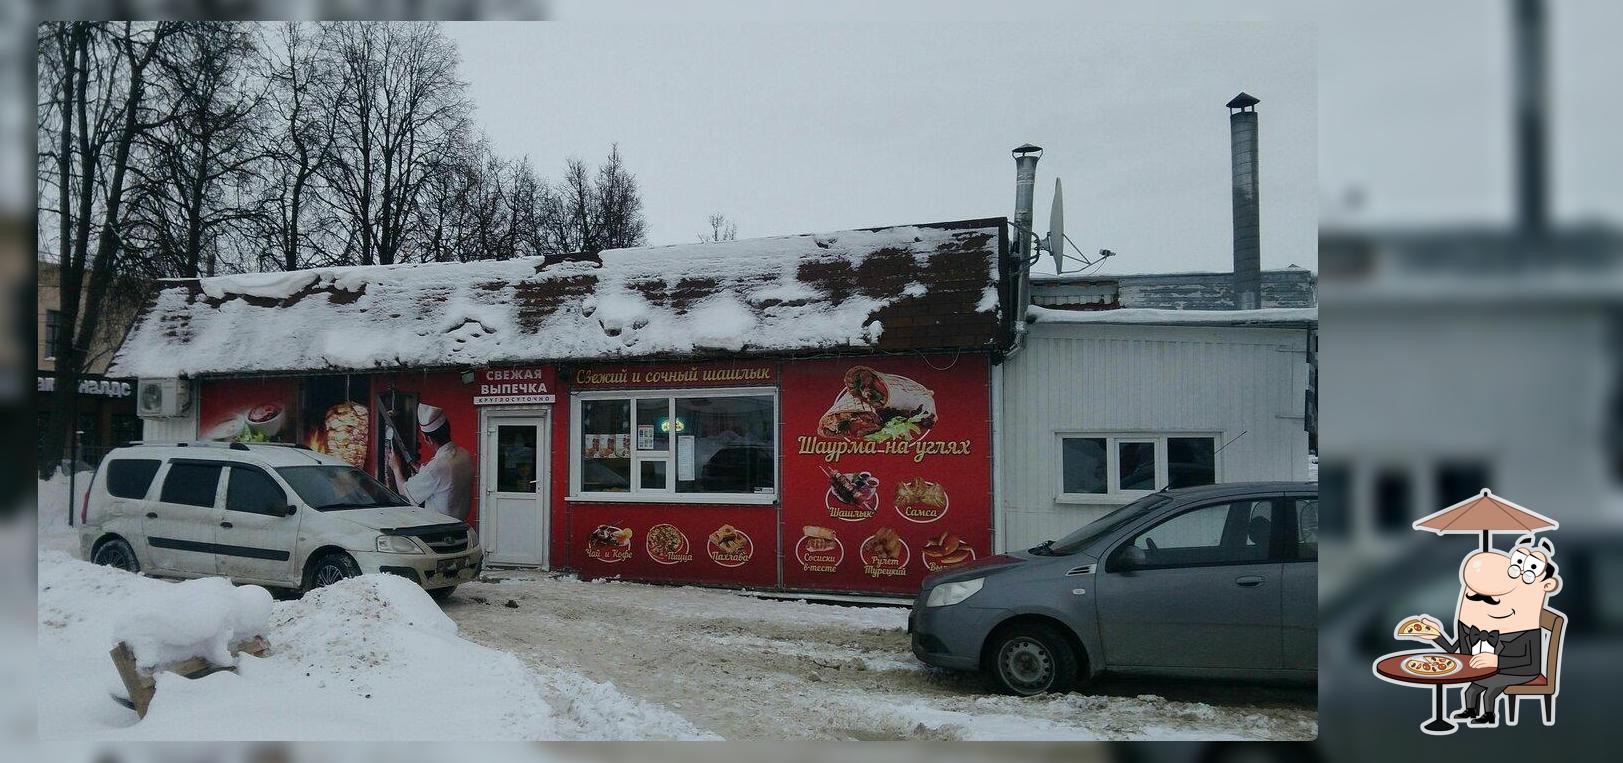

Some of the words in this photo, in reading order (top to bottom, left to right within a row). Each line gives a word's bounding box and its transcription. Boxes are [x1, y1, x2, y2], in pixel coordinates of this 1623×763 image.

[486, 369, 542, 381] СВЕЖАЯ
[576, 369, 627, 384] Свежий
[632, 372, 641, 383] и
[645, 367, 698, 383] сочный
[703, 367, 770, 381] шашлык
[480, 383, 547, 394] ВЫПЕЧКА
[798, 435, 877, 462] Шаурма
[884, 442, 910, 455] на
[914, 439, 971, 463] углях
[829, 506, 875, 518] Шашлык
[905, 506, 937, 517] Самса
[667, 551, 693, 562] Пицца
[803, 553, 836, 563] Сосиски
[872, 555, 900, 569] Рулет
[864, 564, 907, 578] Турецкий
